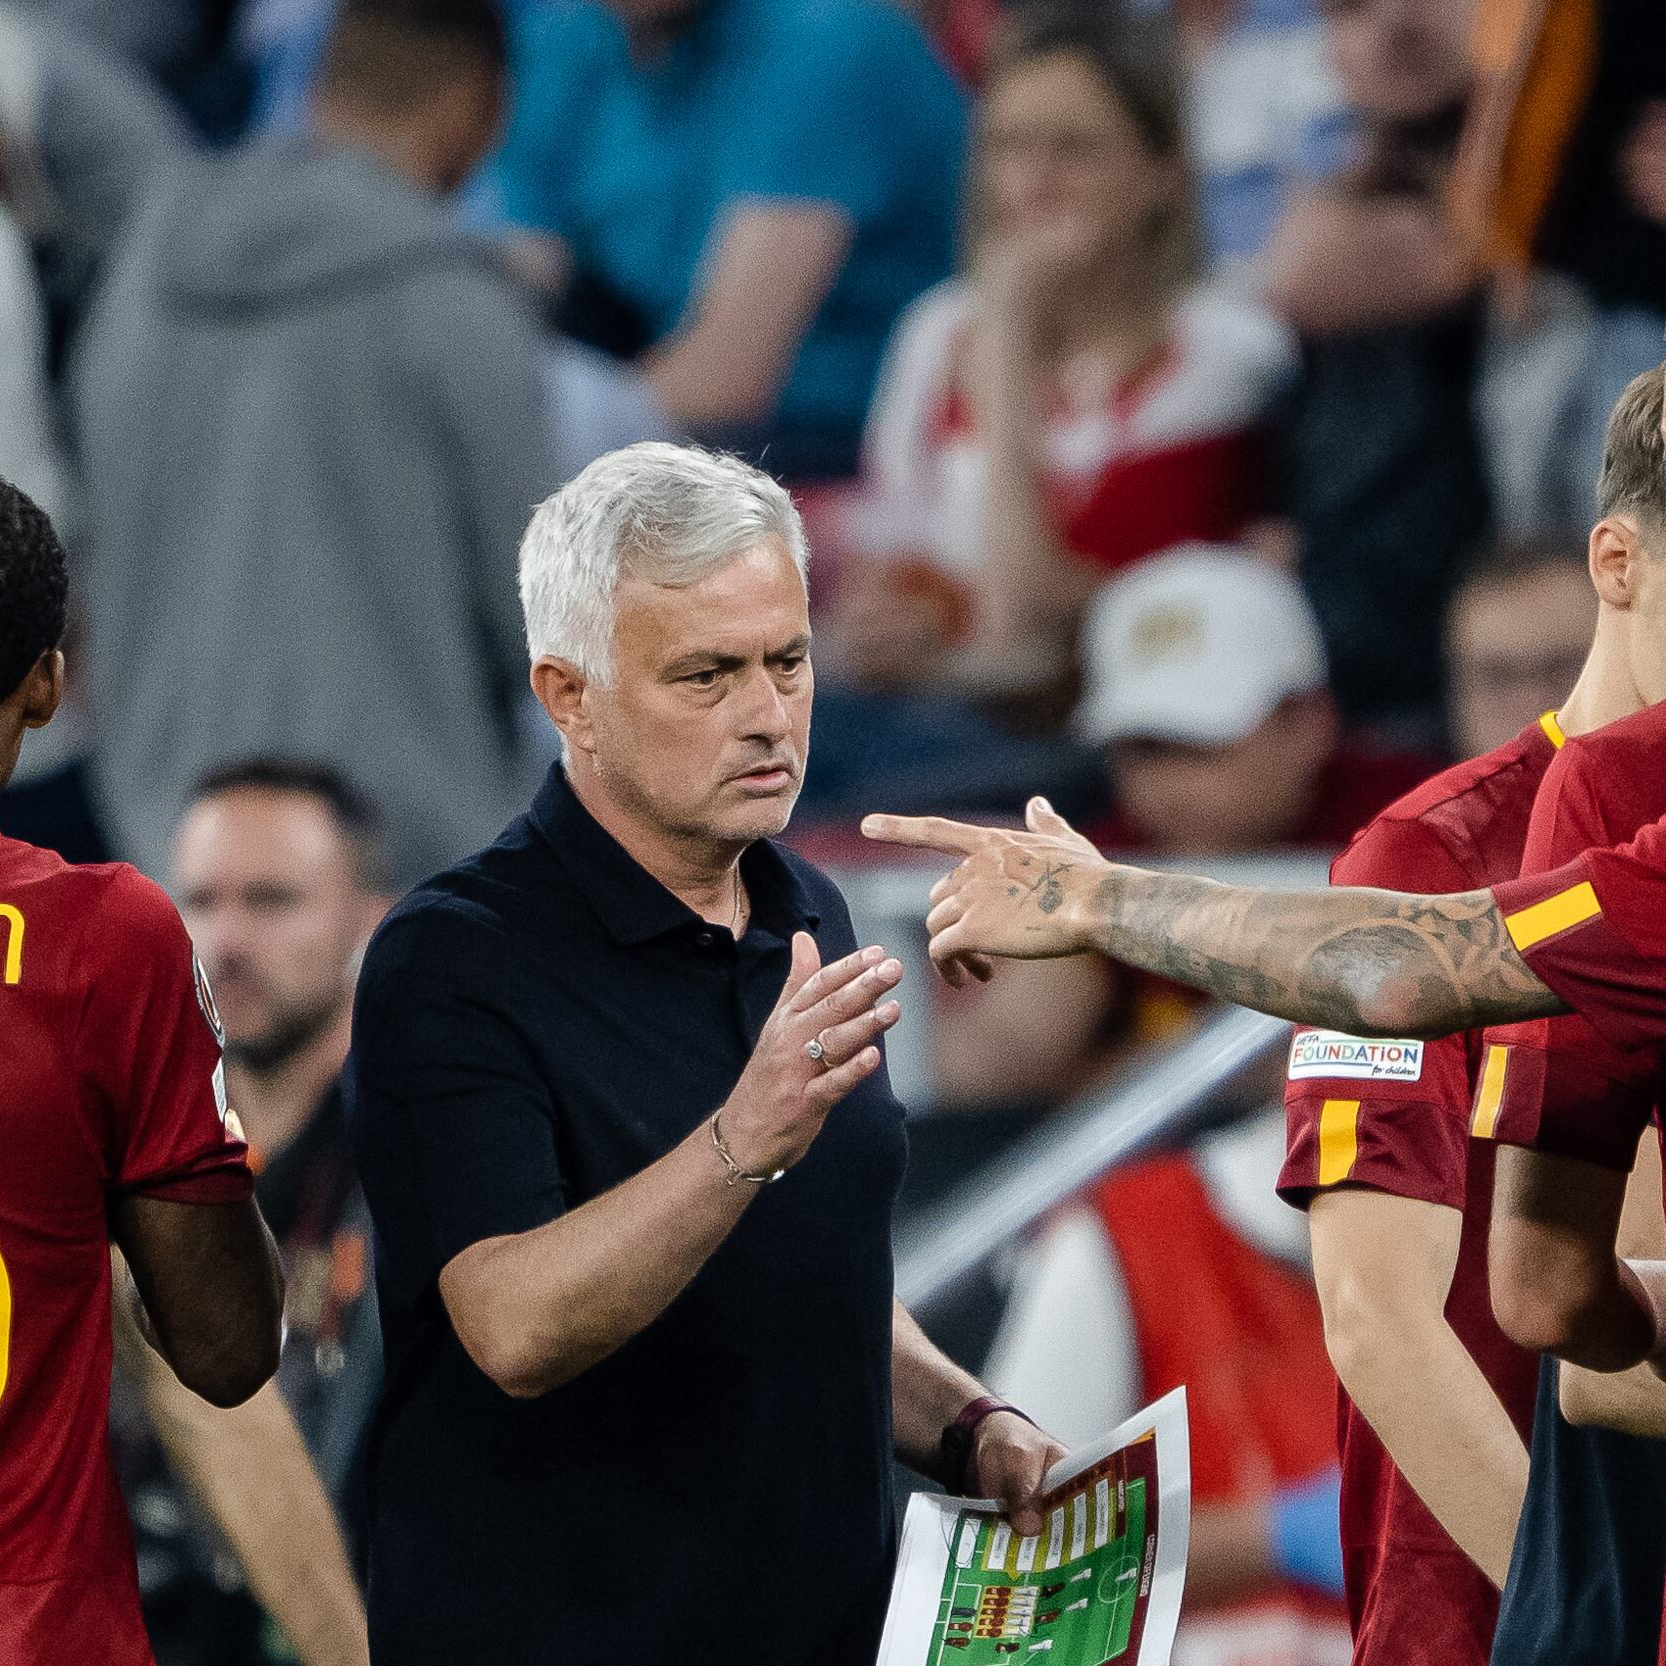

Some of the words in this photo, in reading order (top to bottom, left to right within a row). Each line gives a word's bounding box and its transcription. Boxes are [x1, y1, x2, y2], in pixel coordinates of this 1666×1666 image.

[1296, 1034, 1319, 1046] UEFA
[1293, 1045, 1418, 1063] FOUNDATION
[1372, 1064, 1383, 1075] for
[1385, 1065, 1416, 1076] children
